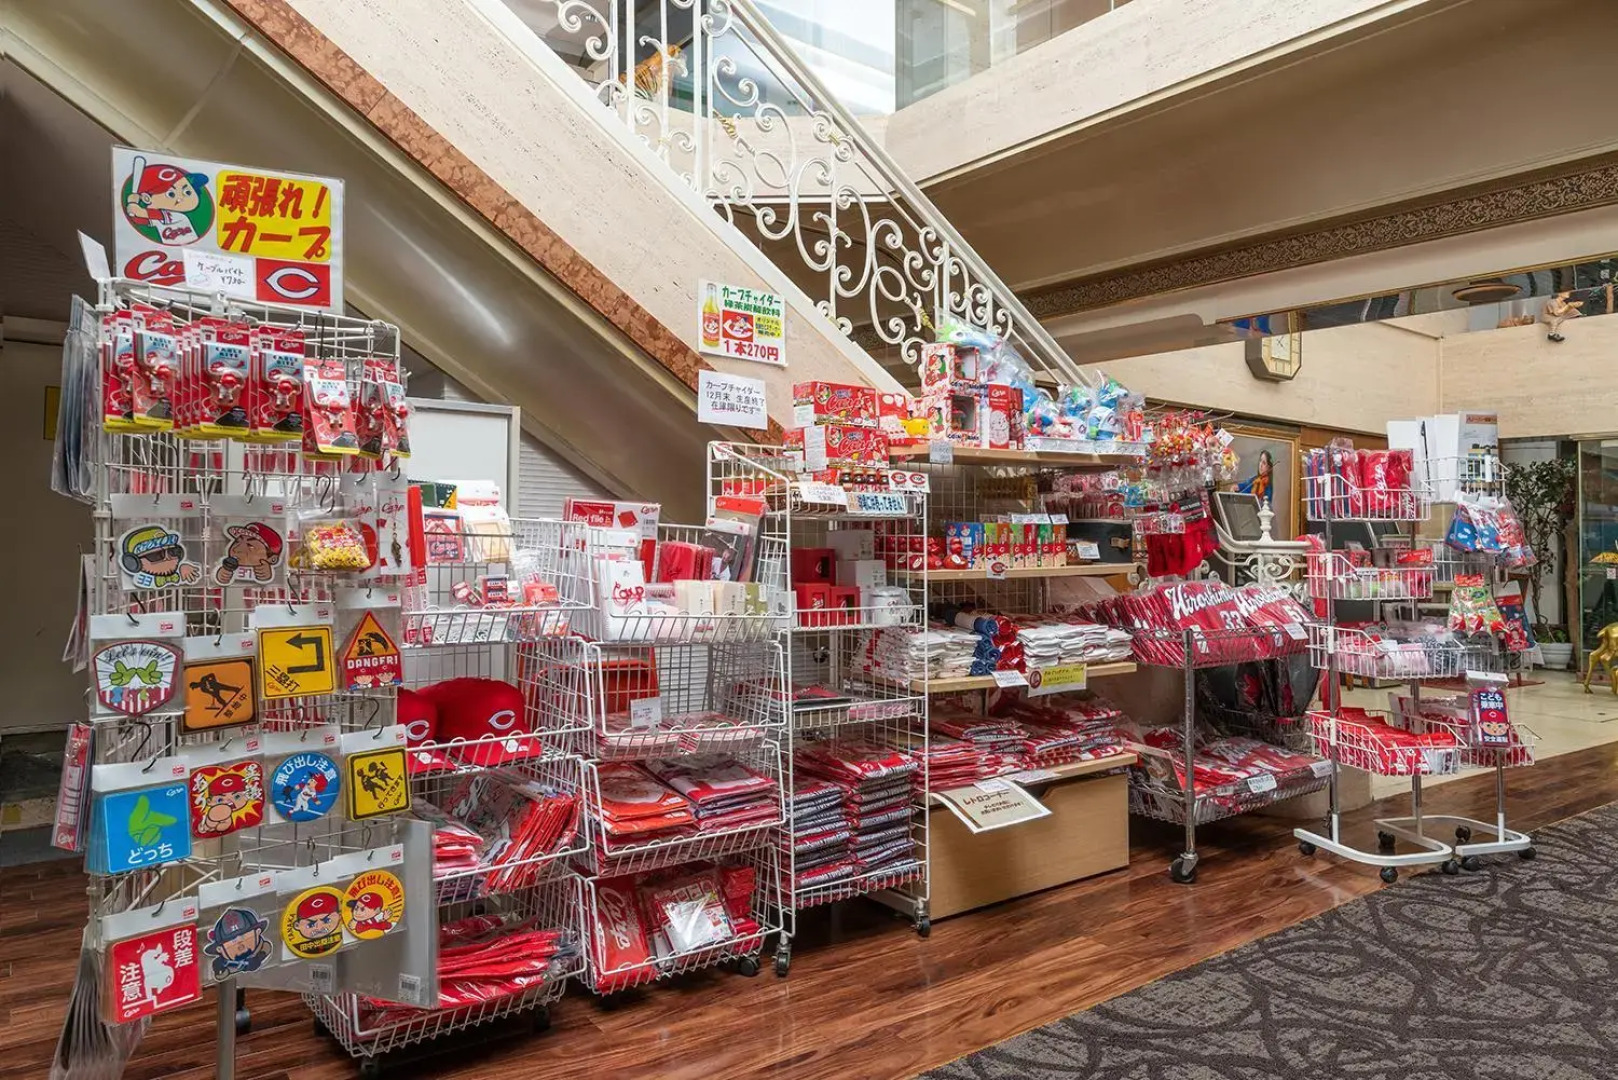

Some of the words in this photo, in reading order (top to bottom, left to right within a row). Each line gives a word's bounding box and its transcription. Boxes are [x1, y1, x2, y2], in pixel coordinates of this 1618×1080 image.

[220, 216, 331, 260] カープ
[124, 250, 187, 286] Ca
[265, 664, 301, 693] 三塁打
[275, 754, 338, 787] 飛び出し注意
[962, 790, 1010, 806] レトロコーナー
[127, 842, 174, 865] どっち
[172, 929, 194, 969] 段差
[119, 962, 143, 1004] 注意
